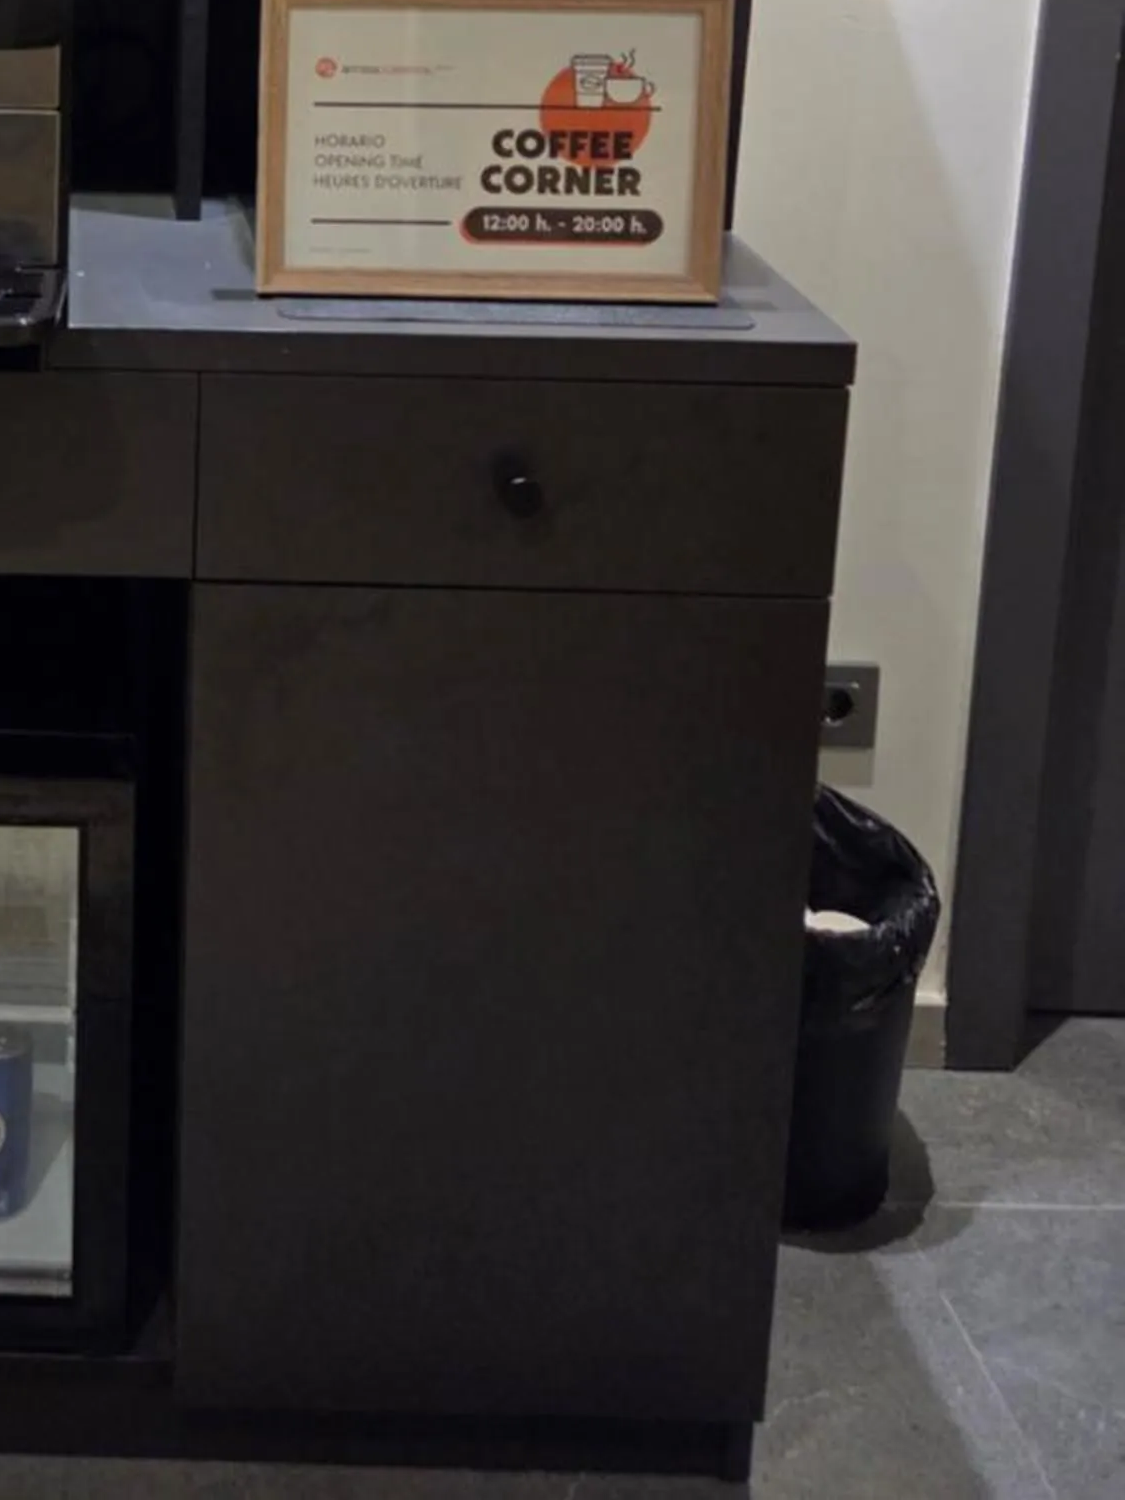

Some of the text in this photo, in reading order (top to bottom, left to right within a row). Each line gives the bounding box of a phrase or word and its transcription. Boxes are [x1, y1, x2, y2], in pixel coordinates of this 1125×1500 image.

[313, 133, 386, 149] HORARIO
[491, 128, 634, 160] COFFEE
[314, 153, 423, 169] OPENING TIME
[313, 173, 370, 189] HEURES
[480, 164, 642, 197] CORNER
[482, 214, 530, 232] 12:00
[535, 213, 552, 232] h.
[572, 216, 625, 233] 20:00
[630, 216, 647, 234] h.
